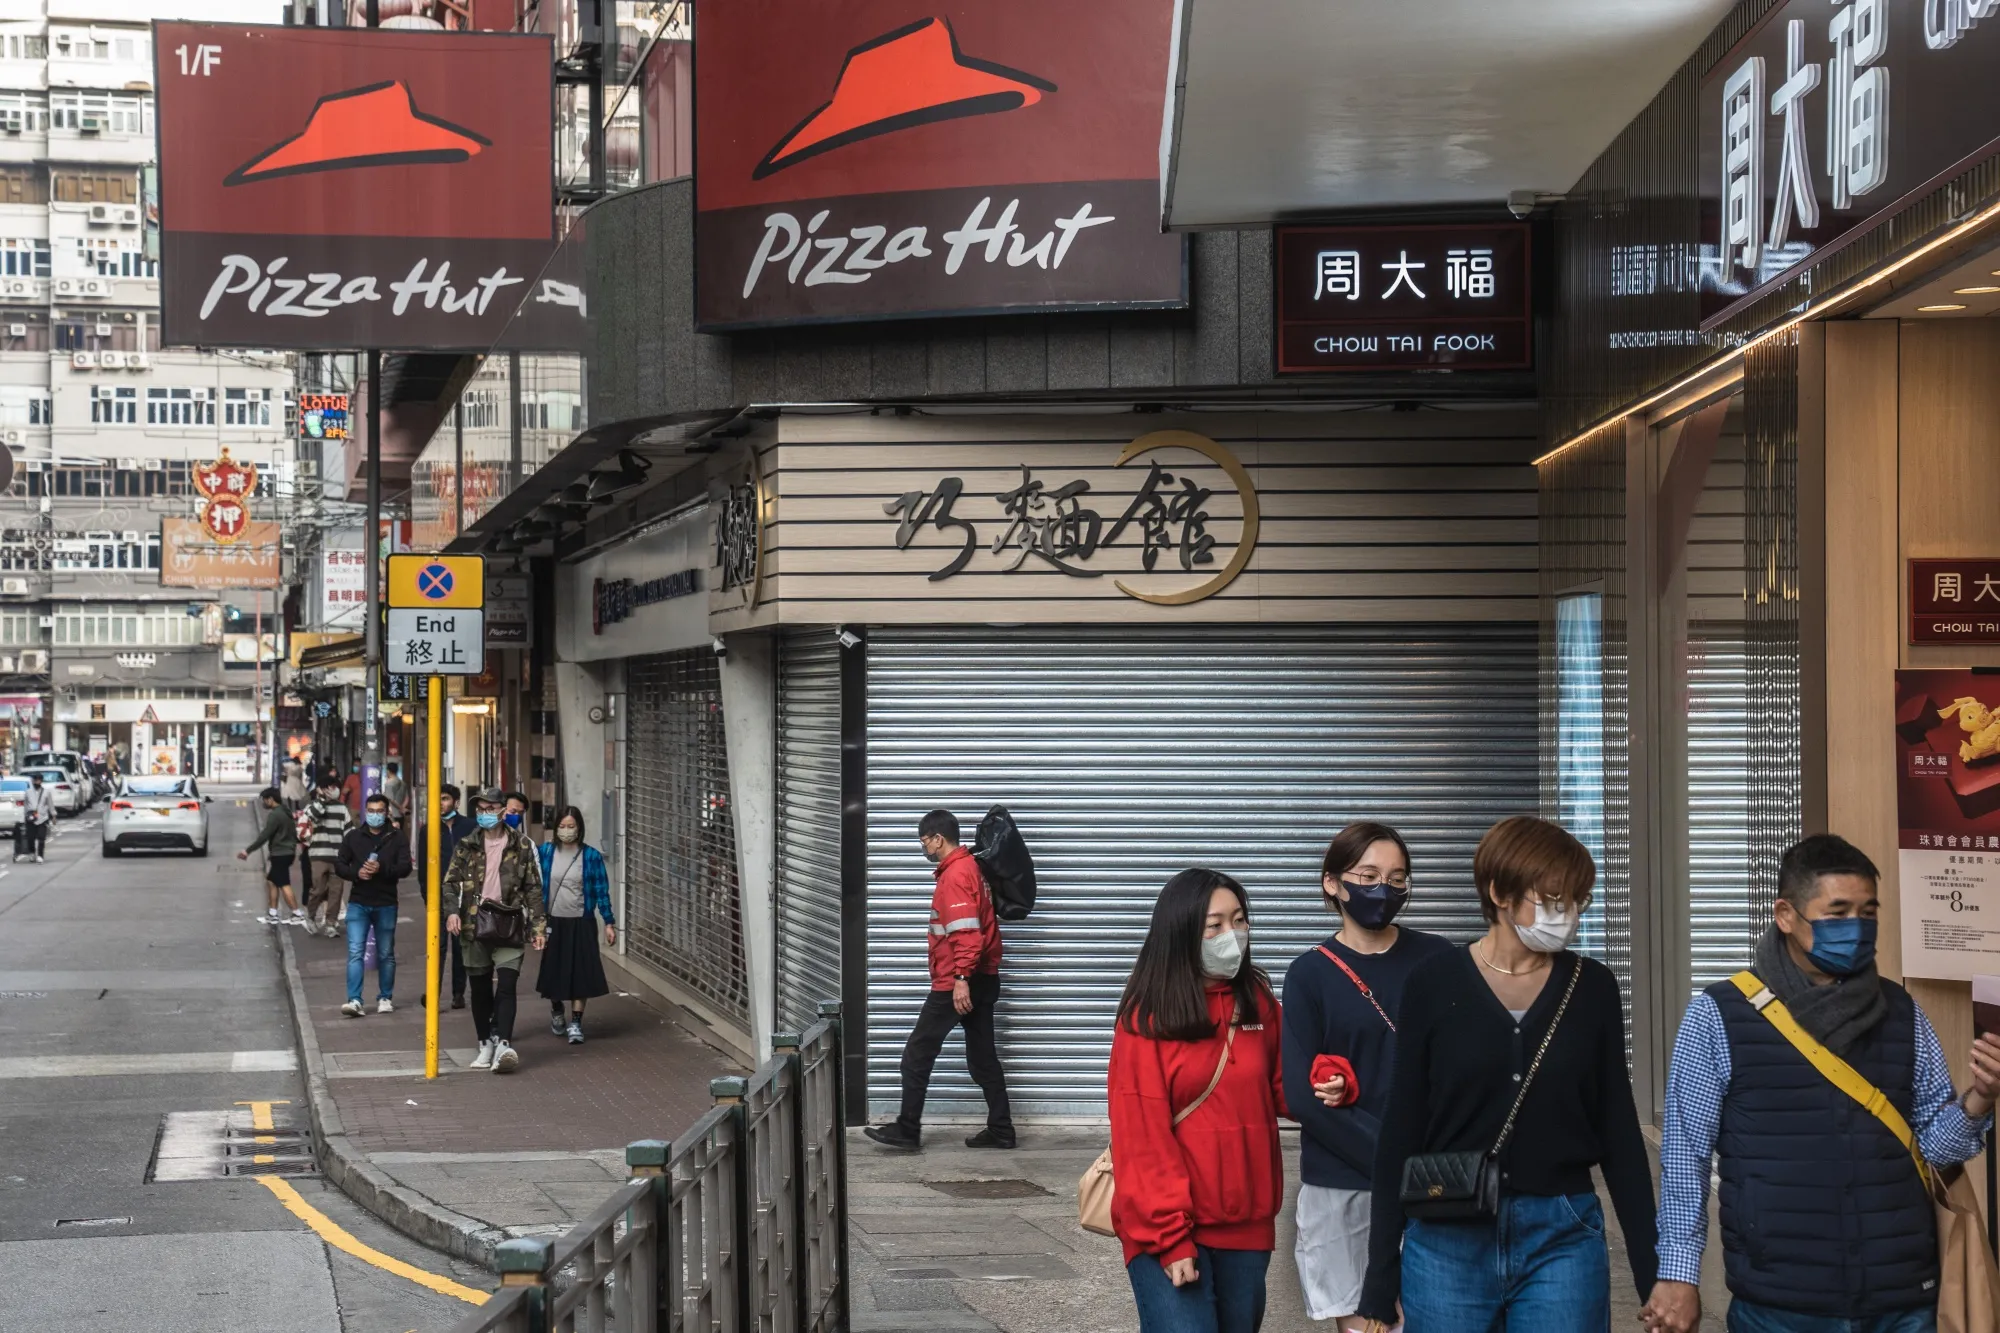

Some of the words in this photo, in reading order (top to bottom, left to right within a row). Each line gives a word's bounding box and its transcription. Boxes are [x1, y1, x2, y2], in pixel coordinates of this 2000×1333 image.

[175, 44, 222, 77] 1/F
[1720, 0, 1890, 284] 周大福
[742, 209, 933, 299] Pizza
[942, 196, 1116, 275] Hut
[200, 254, 382, 320] Pizza
[390, 257, 527, 316] Hut
[1314, 248, 1496, 301] 周大福
[1314, 337, 1378, 353] CHOW
[1386, 336, 1422, 352] TAI
[1433, 335, 1495, 351] FOOK
[1932, 572, 2000, 603] 周大
[416, 615, 456, 633] End
[1932, 623, 1973, 633] CHOW
[1976, 623, 1999, 633] TAI
[405, 639, 466, 666] 終止
[1914, 755, 1948, 766] 周大福
[1950, 890, 1963, 912] 8
